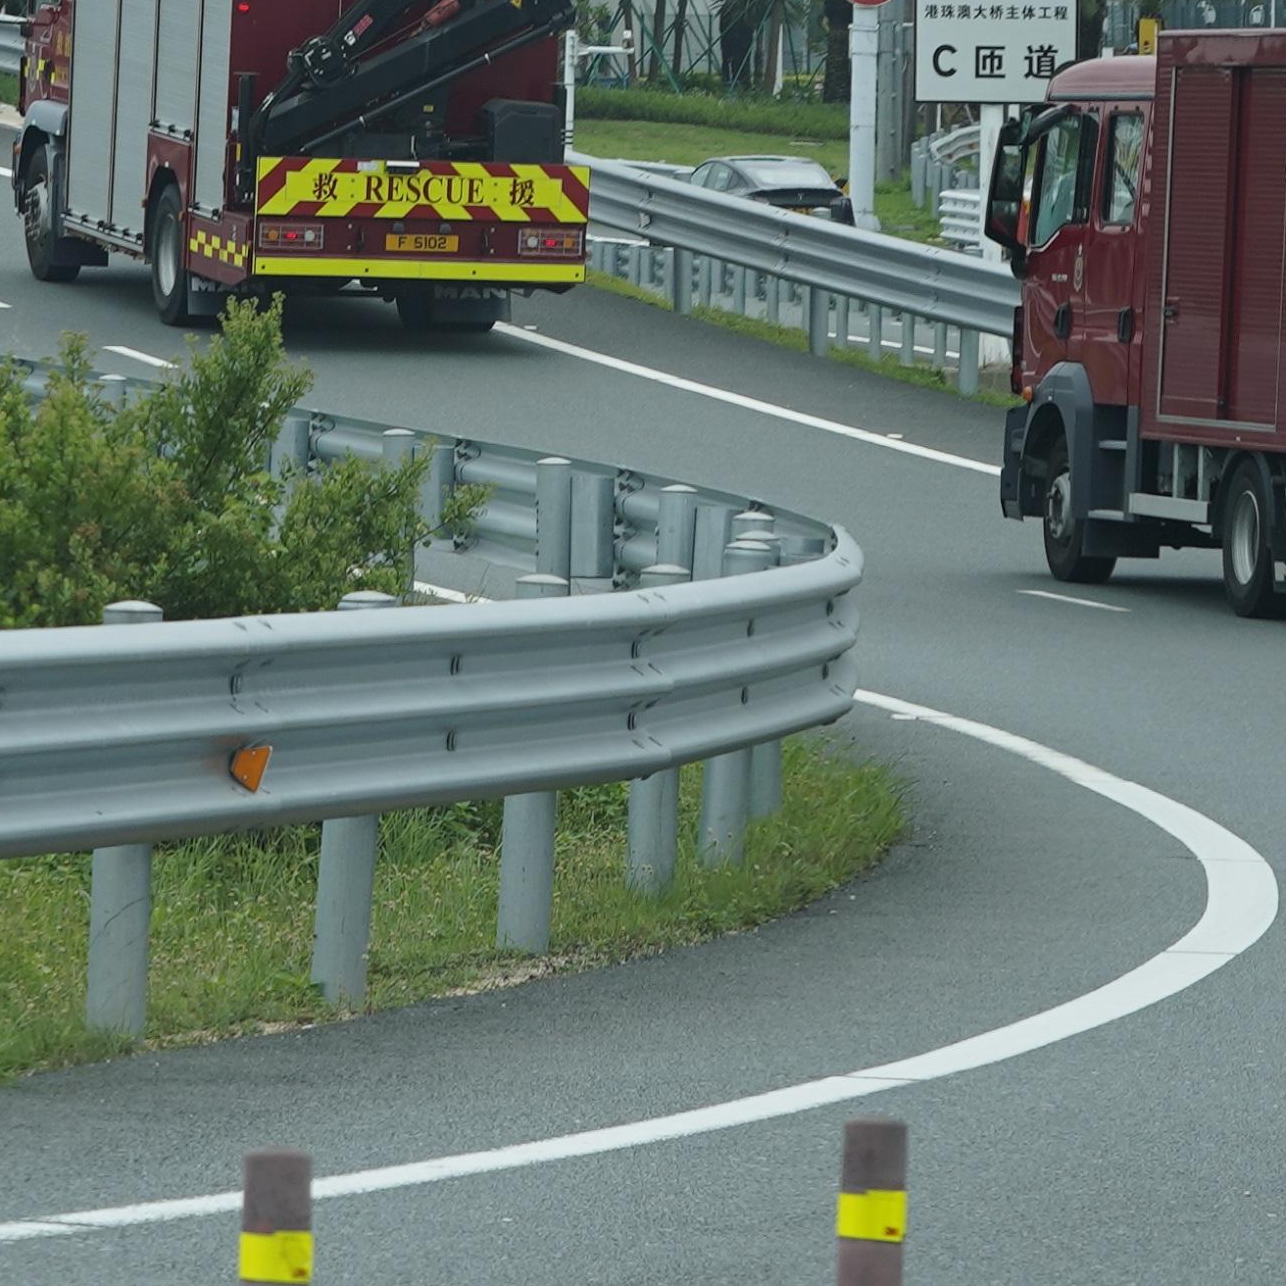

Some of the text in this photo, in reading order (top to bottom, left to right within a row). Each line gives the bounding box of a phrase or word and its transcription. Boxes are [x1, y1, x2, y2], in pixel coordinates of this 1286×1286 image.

[923, 4, 1069, 20] 港珠澳大桥主体工程
[311, 172, 535, 206] 救 RESCUE 援
[398, 235, 448, 250] F 5102
